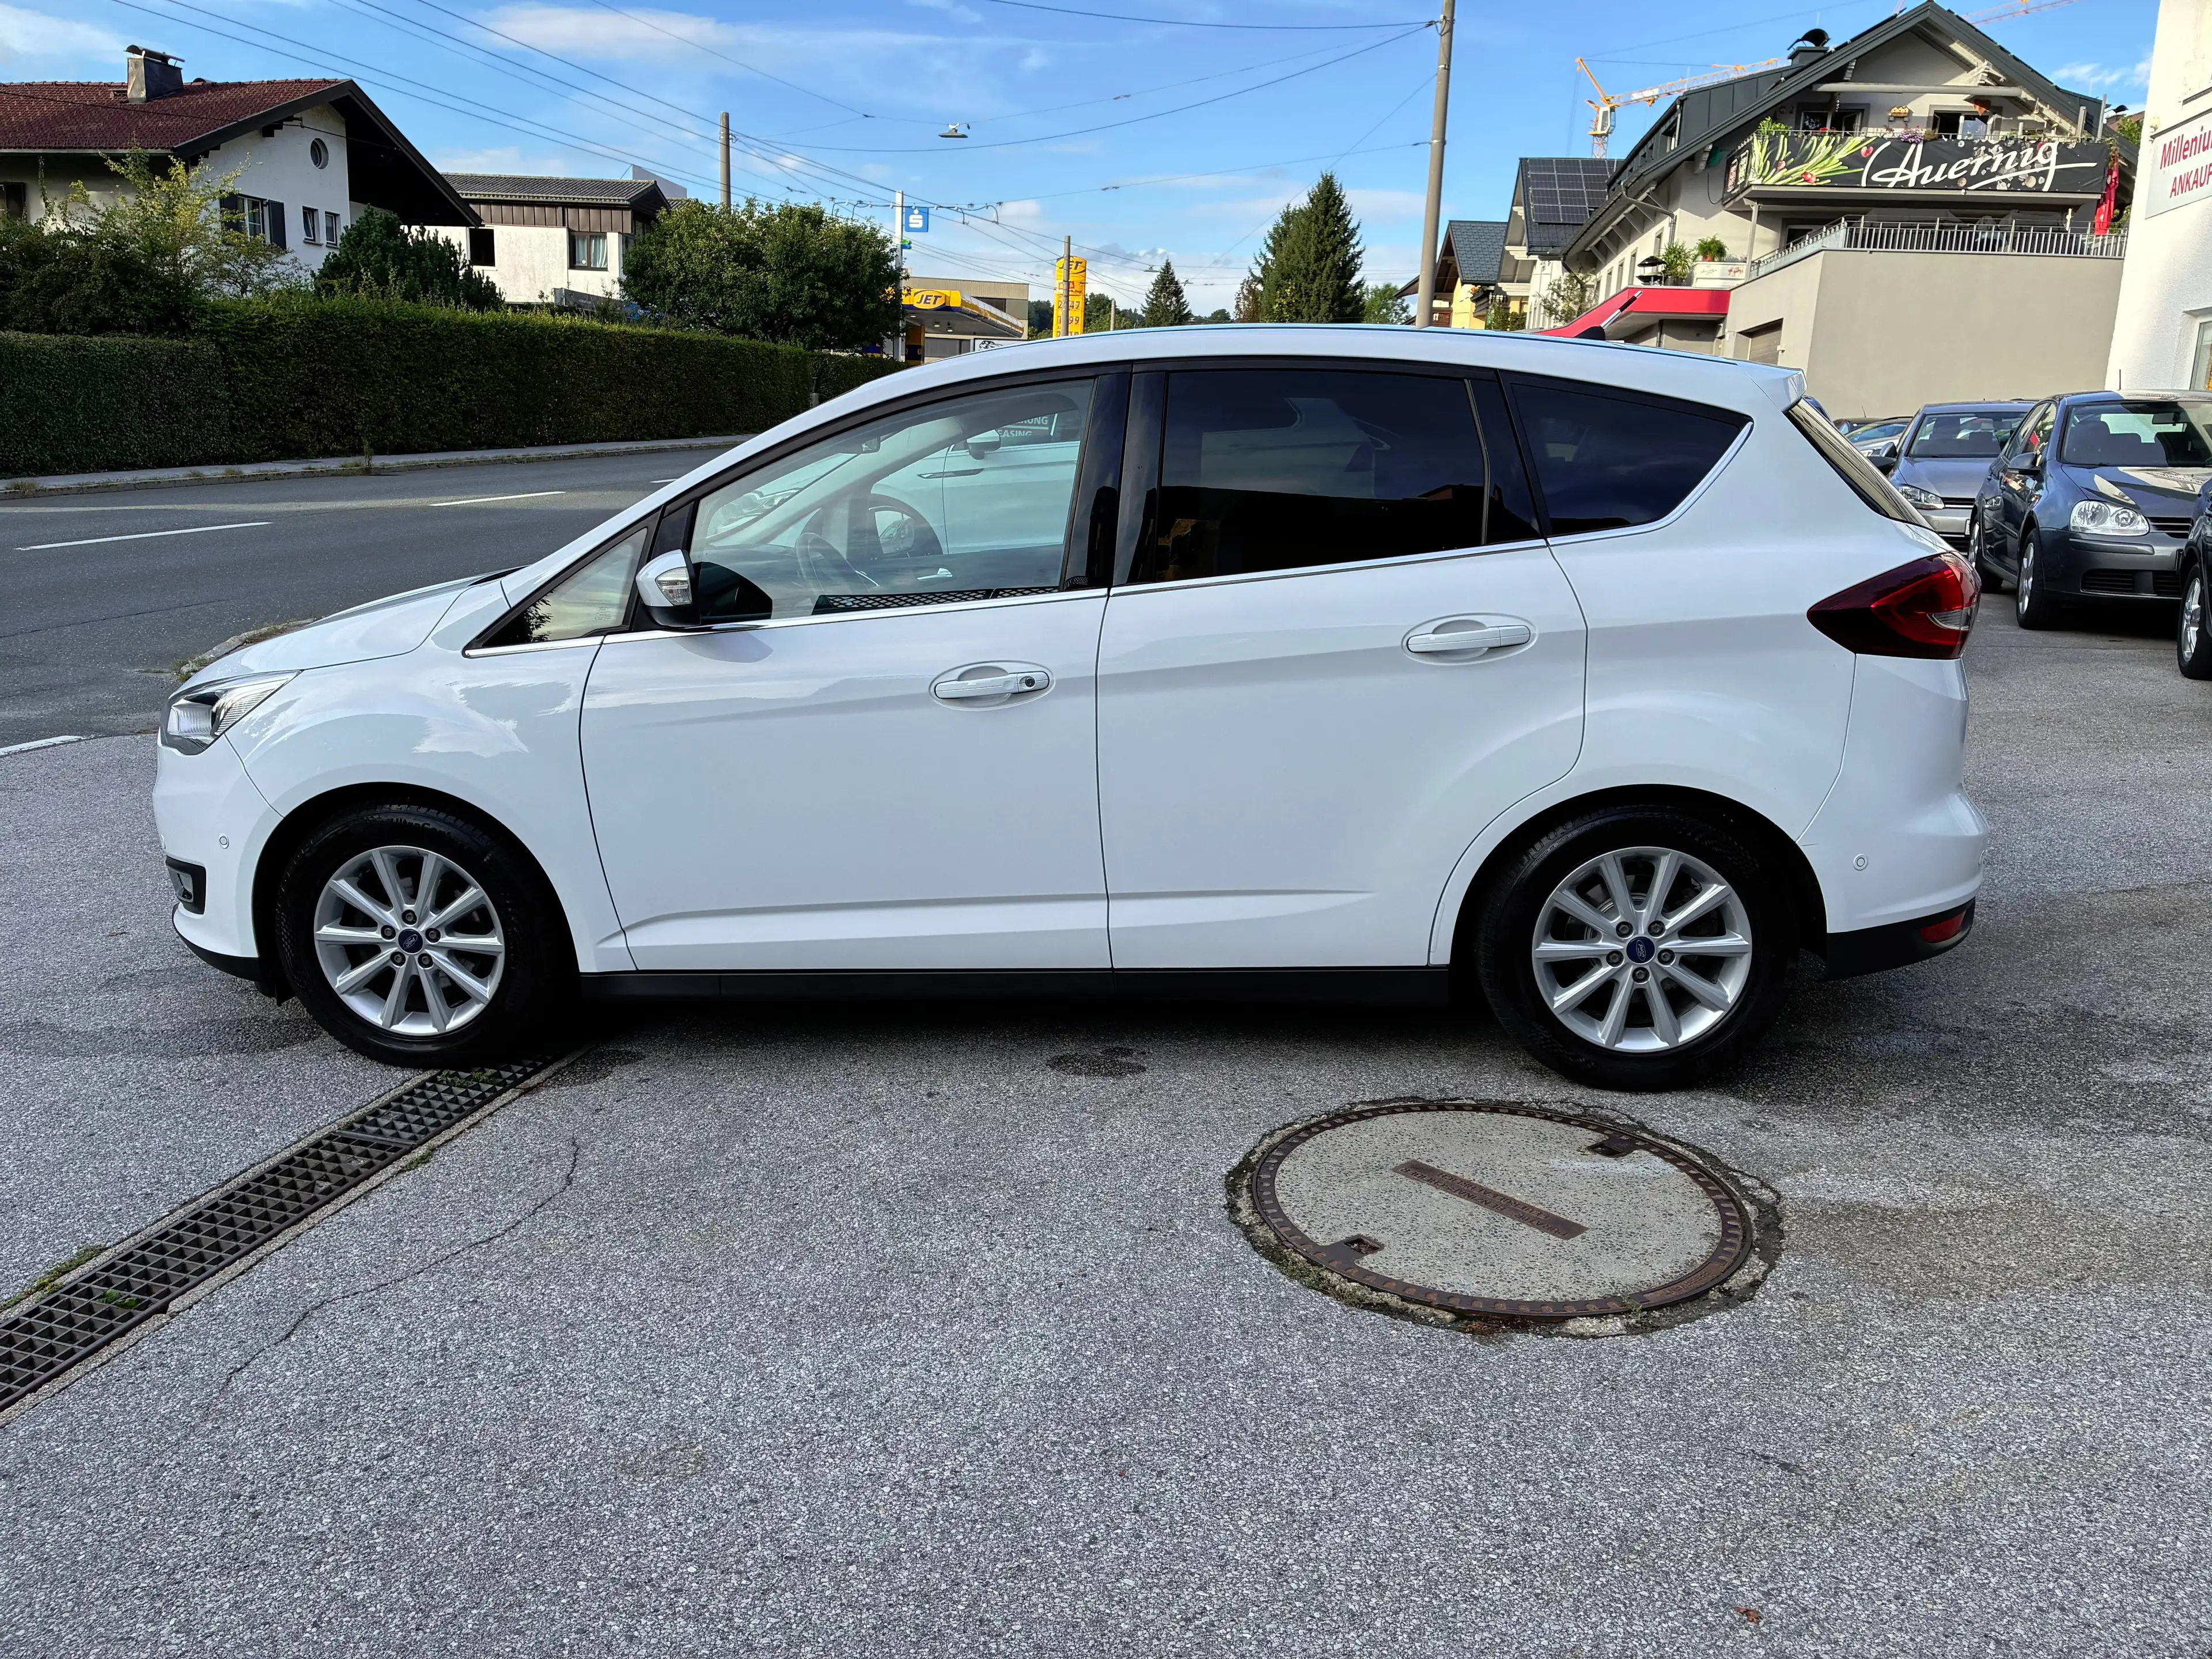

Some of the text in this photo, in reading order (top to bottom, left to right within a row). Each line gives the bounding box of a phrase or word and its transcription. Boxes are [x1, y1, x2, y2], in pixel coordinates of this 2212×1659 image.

[1861, 142, 2097, 192] Auernig
[2160, 126, 2212, 169] Milleniu
[916, 294, 942, 305] JET
